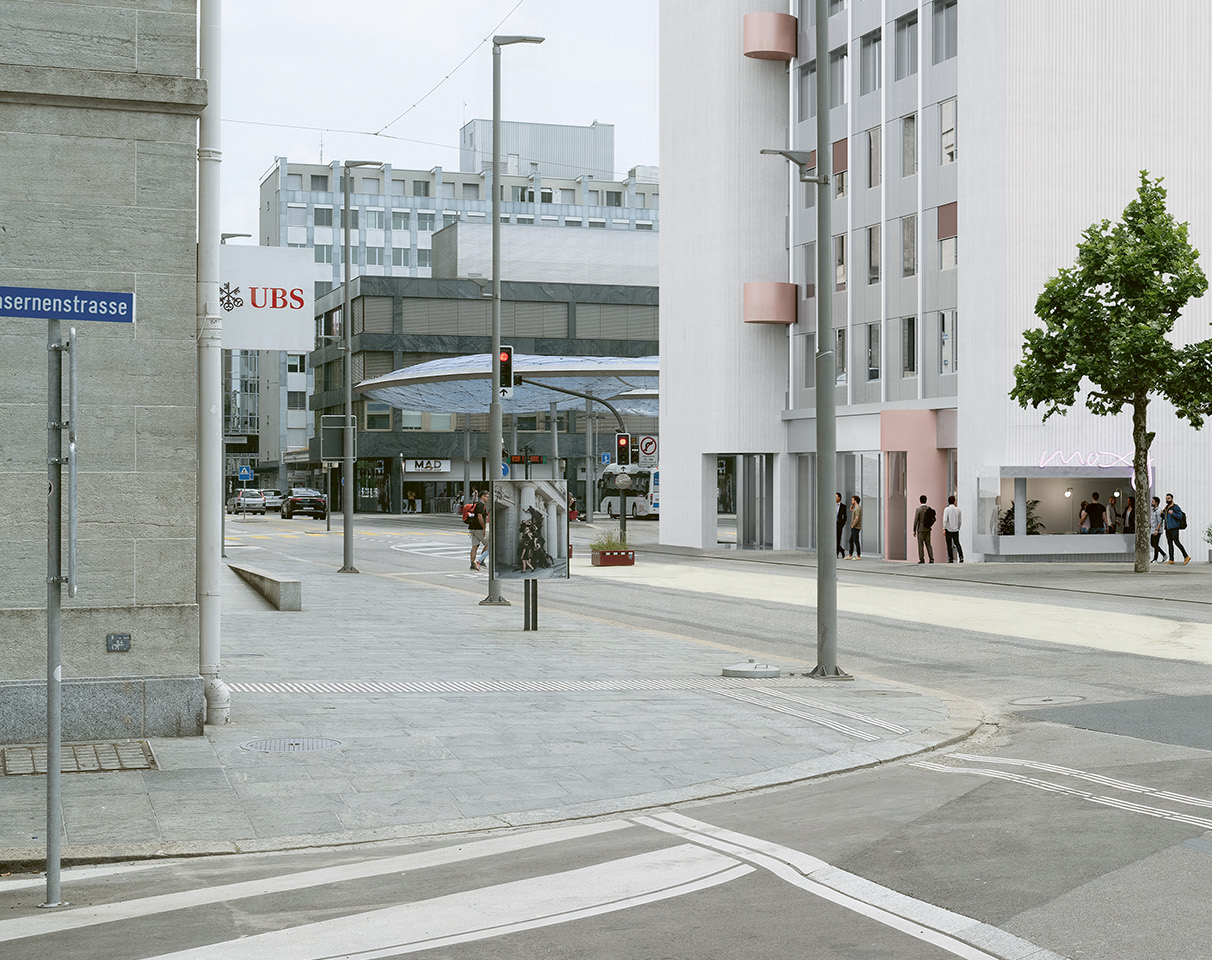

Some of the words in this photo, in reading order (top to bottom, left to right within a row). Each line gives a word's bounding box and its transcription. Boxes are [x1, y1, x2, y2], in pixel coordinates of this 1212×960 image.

[0, 295, 128, 316] sernenstrasse
[248, 286, 305, 310] UBS
[414, 460, 442, 469] MAD
